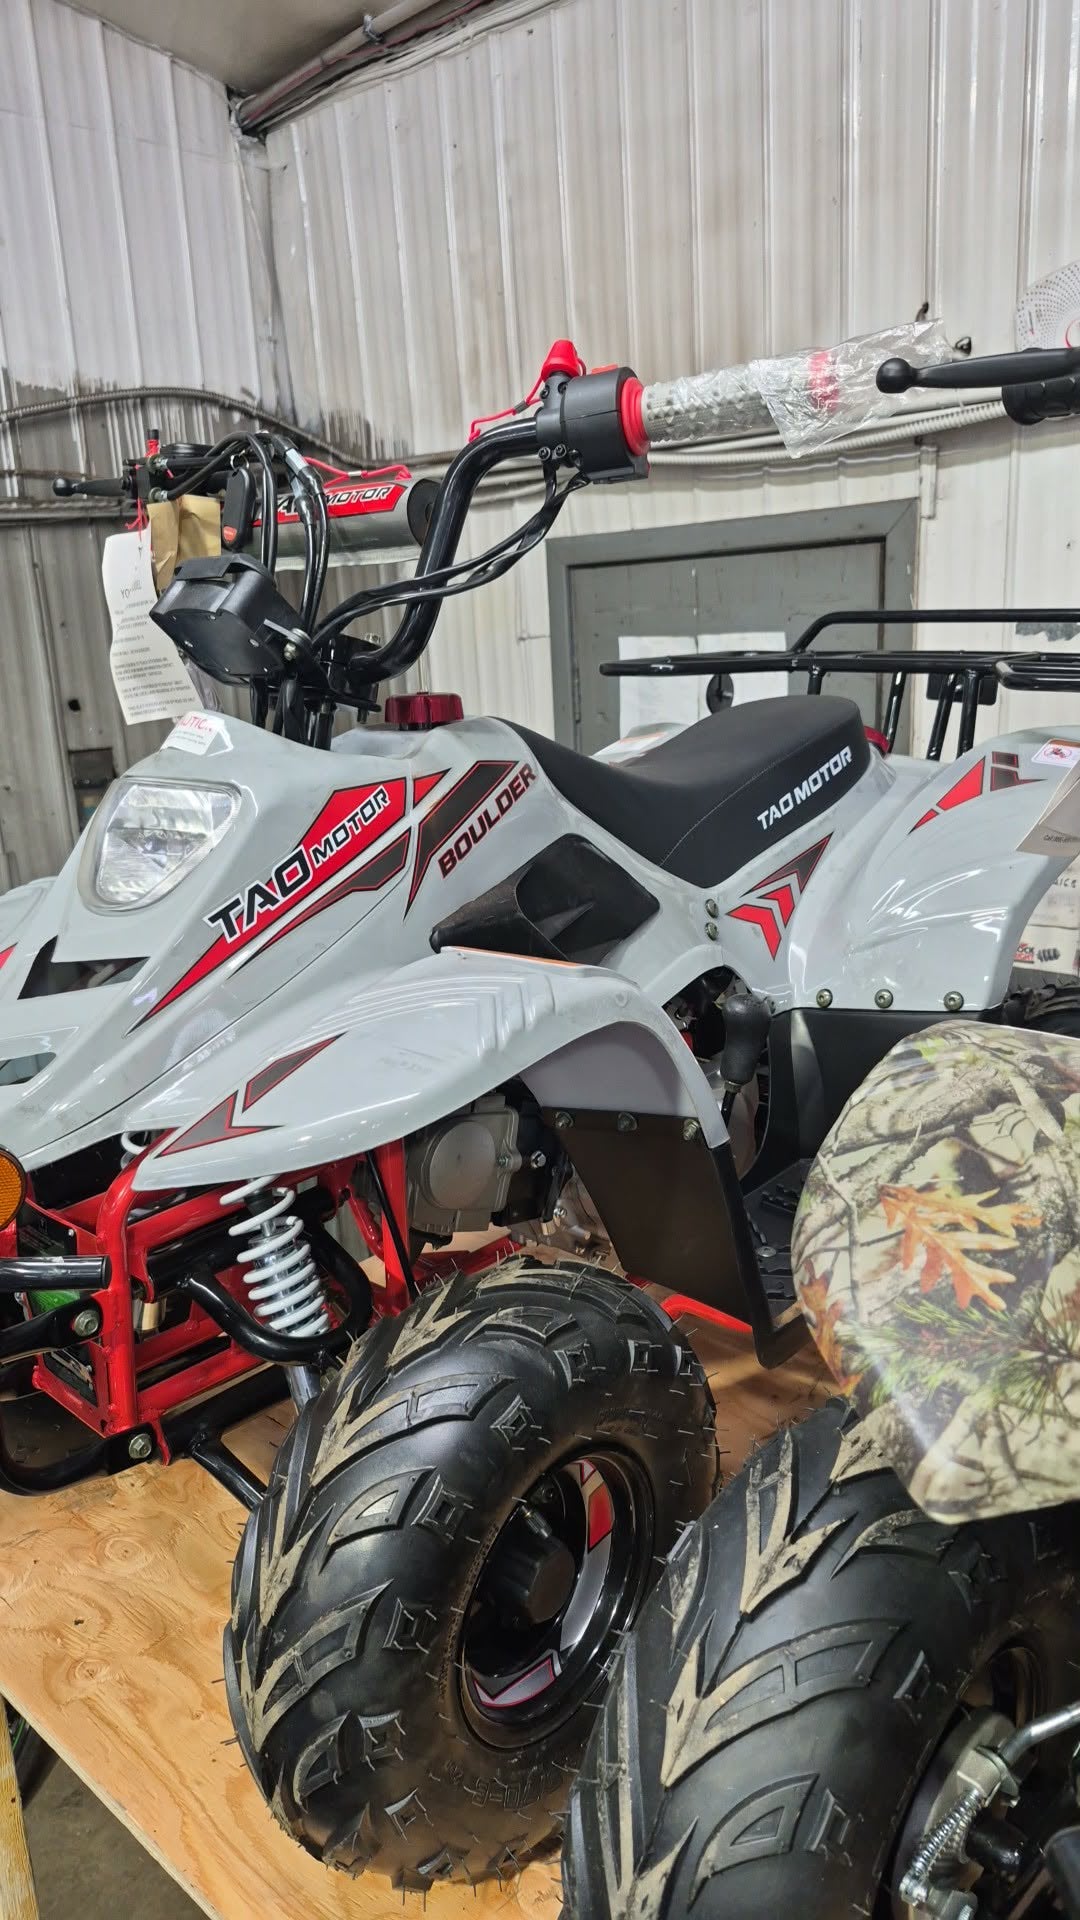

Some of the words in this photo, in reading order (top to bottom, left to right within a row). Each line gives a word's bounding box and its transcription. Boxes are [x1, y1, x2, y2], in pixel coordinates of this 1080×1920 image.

[438, 763, 536, 879] BOULDER
[757, 792, 794, 830] TAO
[793, 746, 852, 805] MOTOR
[204, 847, 313, 943] TAO
[312, 786, 390, 865] MOTOR
